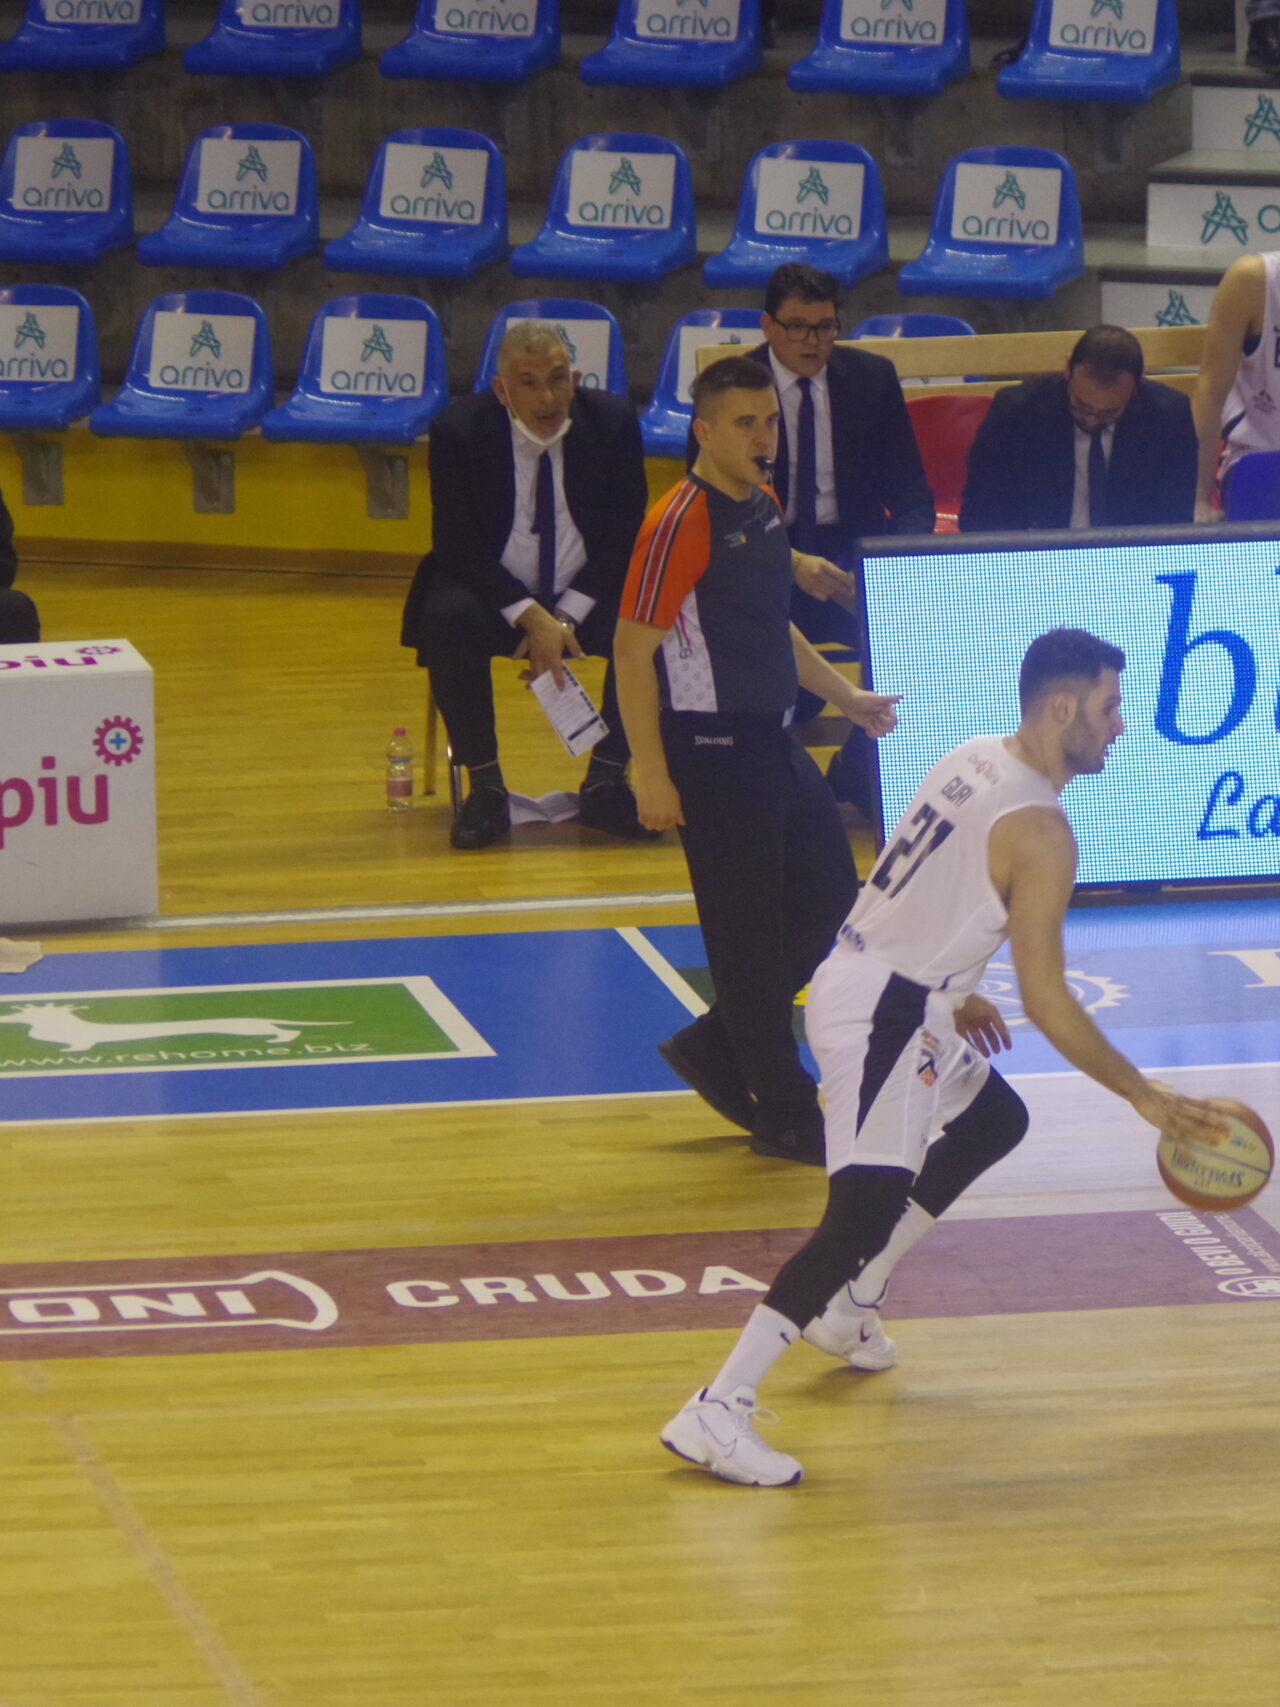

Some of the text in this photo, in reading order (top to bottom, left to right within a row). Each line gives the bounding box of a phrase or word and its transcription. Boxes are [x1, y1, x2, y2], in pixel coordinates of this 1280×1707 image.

[56, 0, 135, 22] arriva
[251, 0, 333, 27] arriva
[446, 0, 529, 32] arriva
[646, 6, 731, 38] arriva
[851, 9, 937, 42] arriva
[1060, 17, 1146, 51] arriva
[23, 182, 103, 209] arriva
[207, 184, 290, 212] arriva
[390, 189, 475, 221] arriva
[579, 196, 664, 226] arriva
[766, 202, 852, 236] arriva
[962, 208, 1050, 242] arriva
[0, 351, 67, 379] rriva
[160, 356, 243, 390] arriva
[331, 361, 416, 394] arriva
[0, 1041, 374, 1068] www.rehome.biz
[386, 1265, 771, 1309] CRUDA
